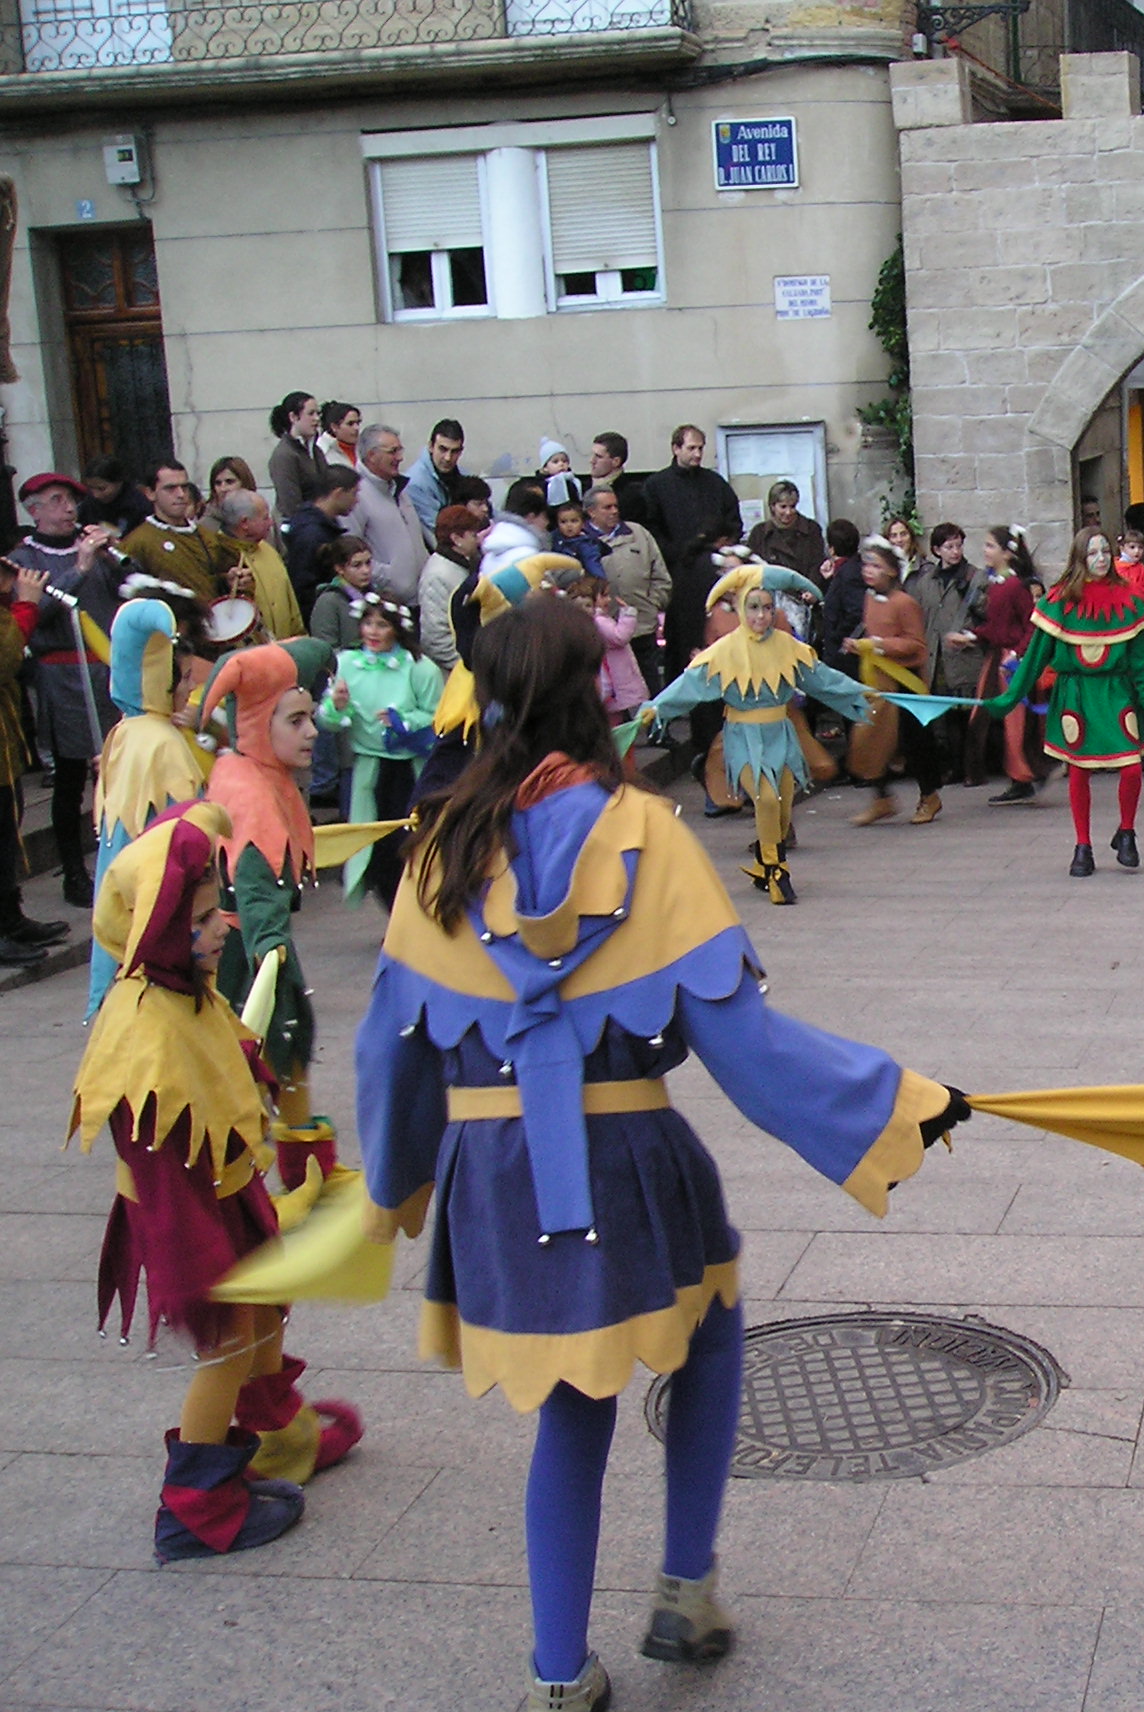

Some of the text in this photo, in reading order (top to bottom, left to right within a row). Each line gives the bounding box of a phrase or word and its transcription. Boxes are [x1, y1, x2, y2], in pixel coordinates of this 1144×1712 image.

[736, 124, 789, 140] Avenida
[732, 143, 776, 162] DEL REY
[729, 165, 753, 183] JUAN
[754, 164, 788, 182] CARLOS
[81, 200, 92, 218] 2
